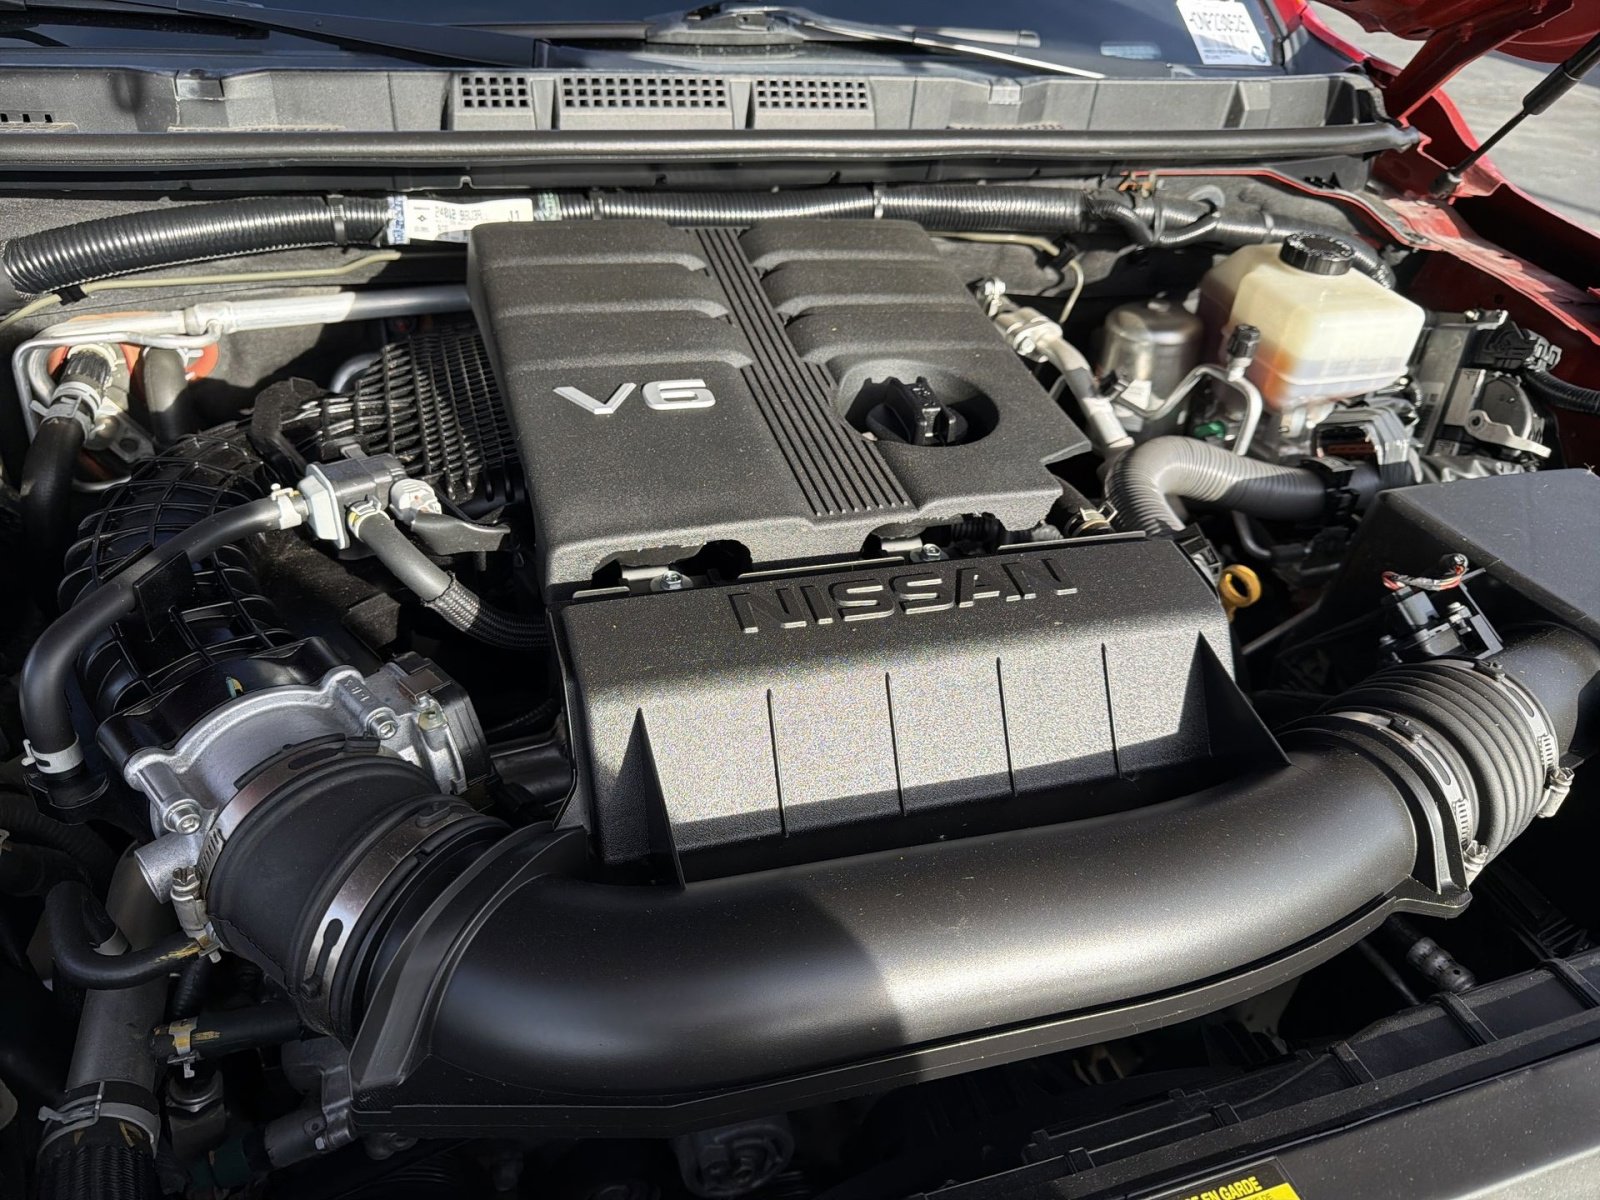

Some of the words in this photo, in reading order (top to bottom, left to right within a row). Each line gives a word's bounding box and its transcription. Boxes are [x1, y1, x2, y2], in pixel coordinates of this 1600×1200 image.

[552, 378, 716, 415] V6
[727, 558, 1078, 634] NISSAN
[1218, 1176, 1263, 1200] GARDE
